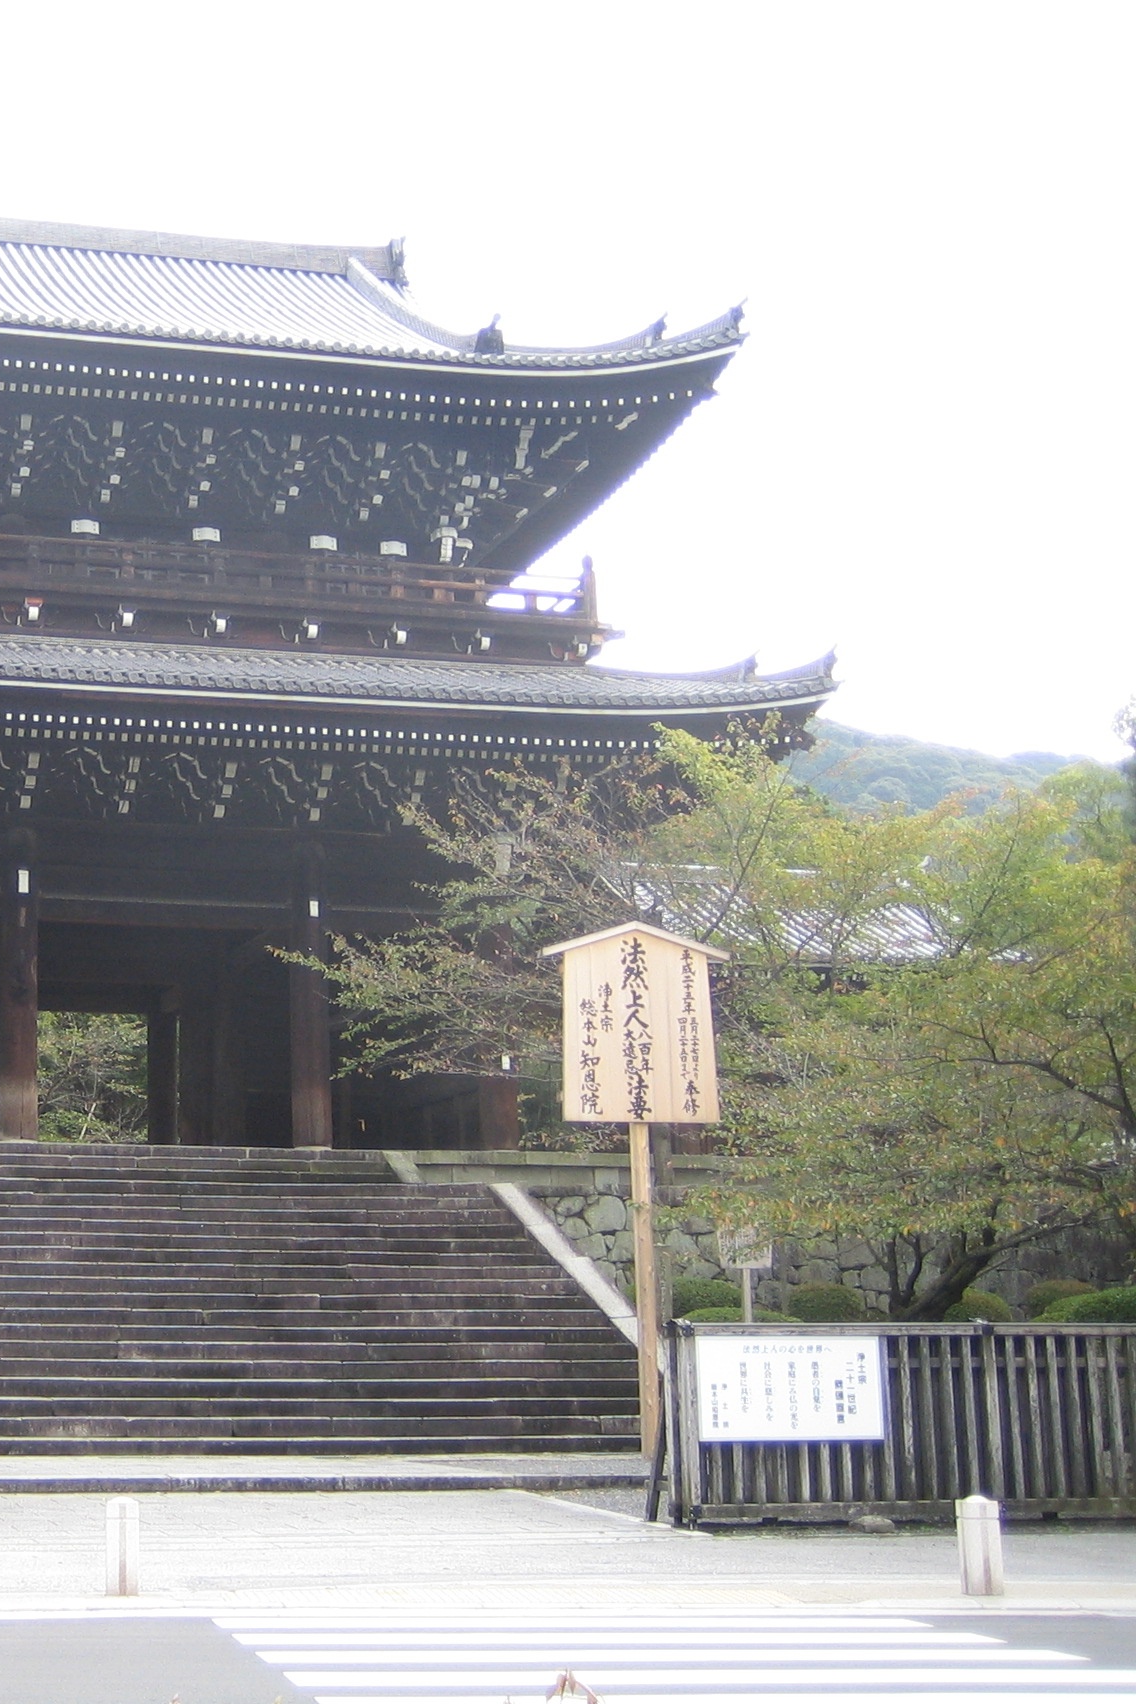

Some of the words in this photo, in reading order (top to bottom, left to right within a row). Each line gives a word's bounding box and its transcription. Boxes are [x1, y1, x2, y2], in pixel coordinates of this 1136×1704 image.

[620, 937, 649, 1029] 法然上人
[627, 1073, 652, 1121] 法要
